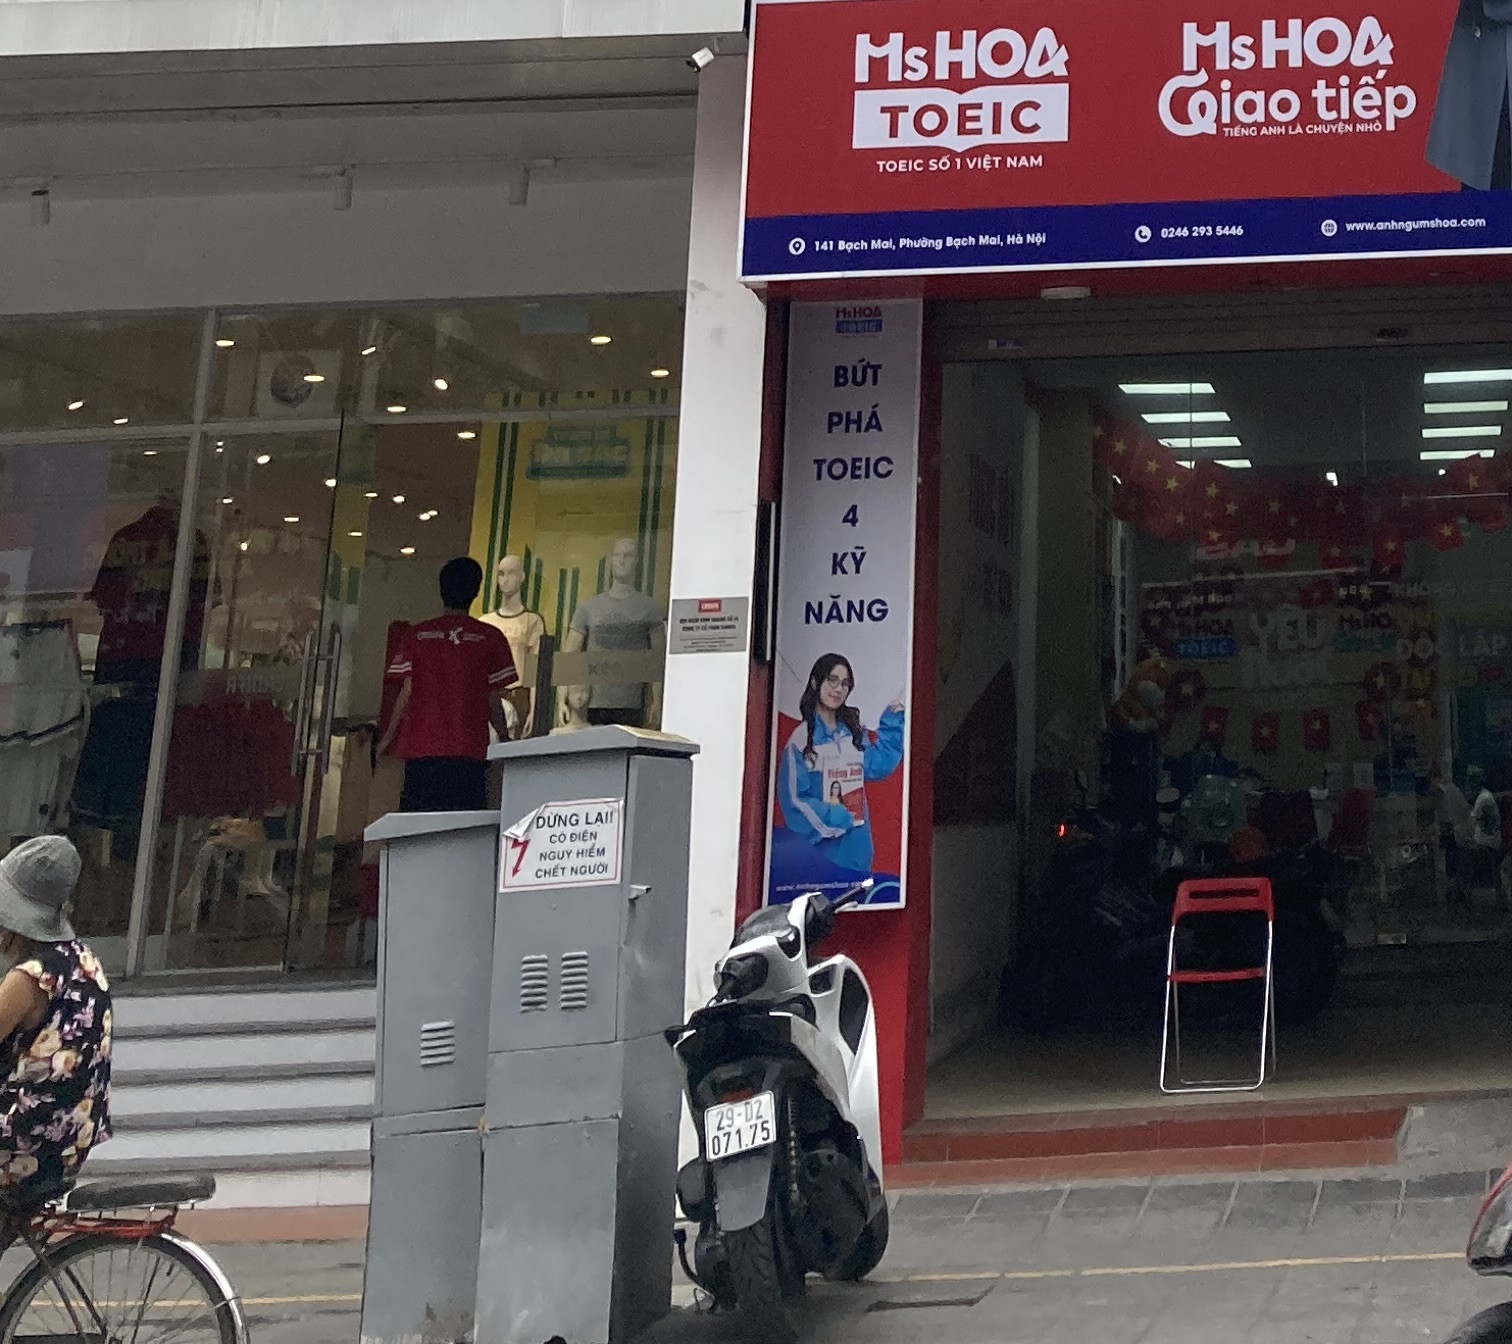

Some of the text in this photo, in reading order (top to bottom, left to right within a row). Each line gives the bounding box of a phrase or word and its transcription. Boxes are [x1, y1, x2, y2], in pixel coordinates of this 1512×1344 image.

[1311, 69, 1417, 132] tiếp
[880, 100, 1042, 138] TOEIC
[1222, 119, 1382, 137] TIẾNG ANH LÀ CHUYỆN NHỎ
[876, 154, 1043, 173] TOEIC SỐ 1 VIỆT NAM
[1161, 224, 1244, 238] 0246 293 5446
[1346, 216, 1486, 233] www.anhngumshoa.com
[815, 232, 1046, 253] 141 Bạch Mai, Phường Bạch Mai, Hà Nội
[833, 357, 883, 388] BỨT
[827, 403, 883, 434] PHÁ
[812, 456, 894, 481] TOEIC
[841, 503, 859, 527] 4
[831, 545, 866, 576] KỸ
[804, 594, 889, 625] NĂNG
[536, 812, 579, 829] DỪNG
[549, 830, 598, 845] CÓ ĐIỆN
[539, 842, 606, 862] NGUY HIỂM
[535, 862, 609, 879] CHẾT NGƯỜI
[712, 1120, 770, 1156] 071.75
